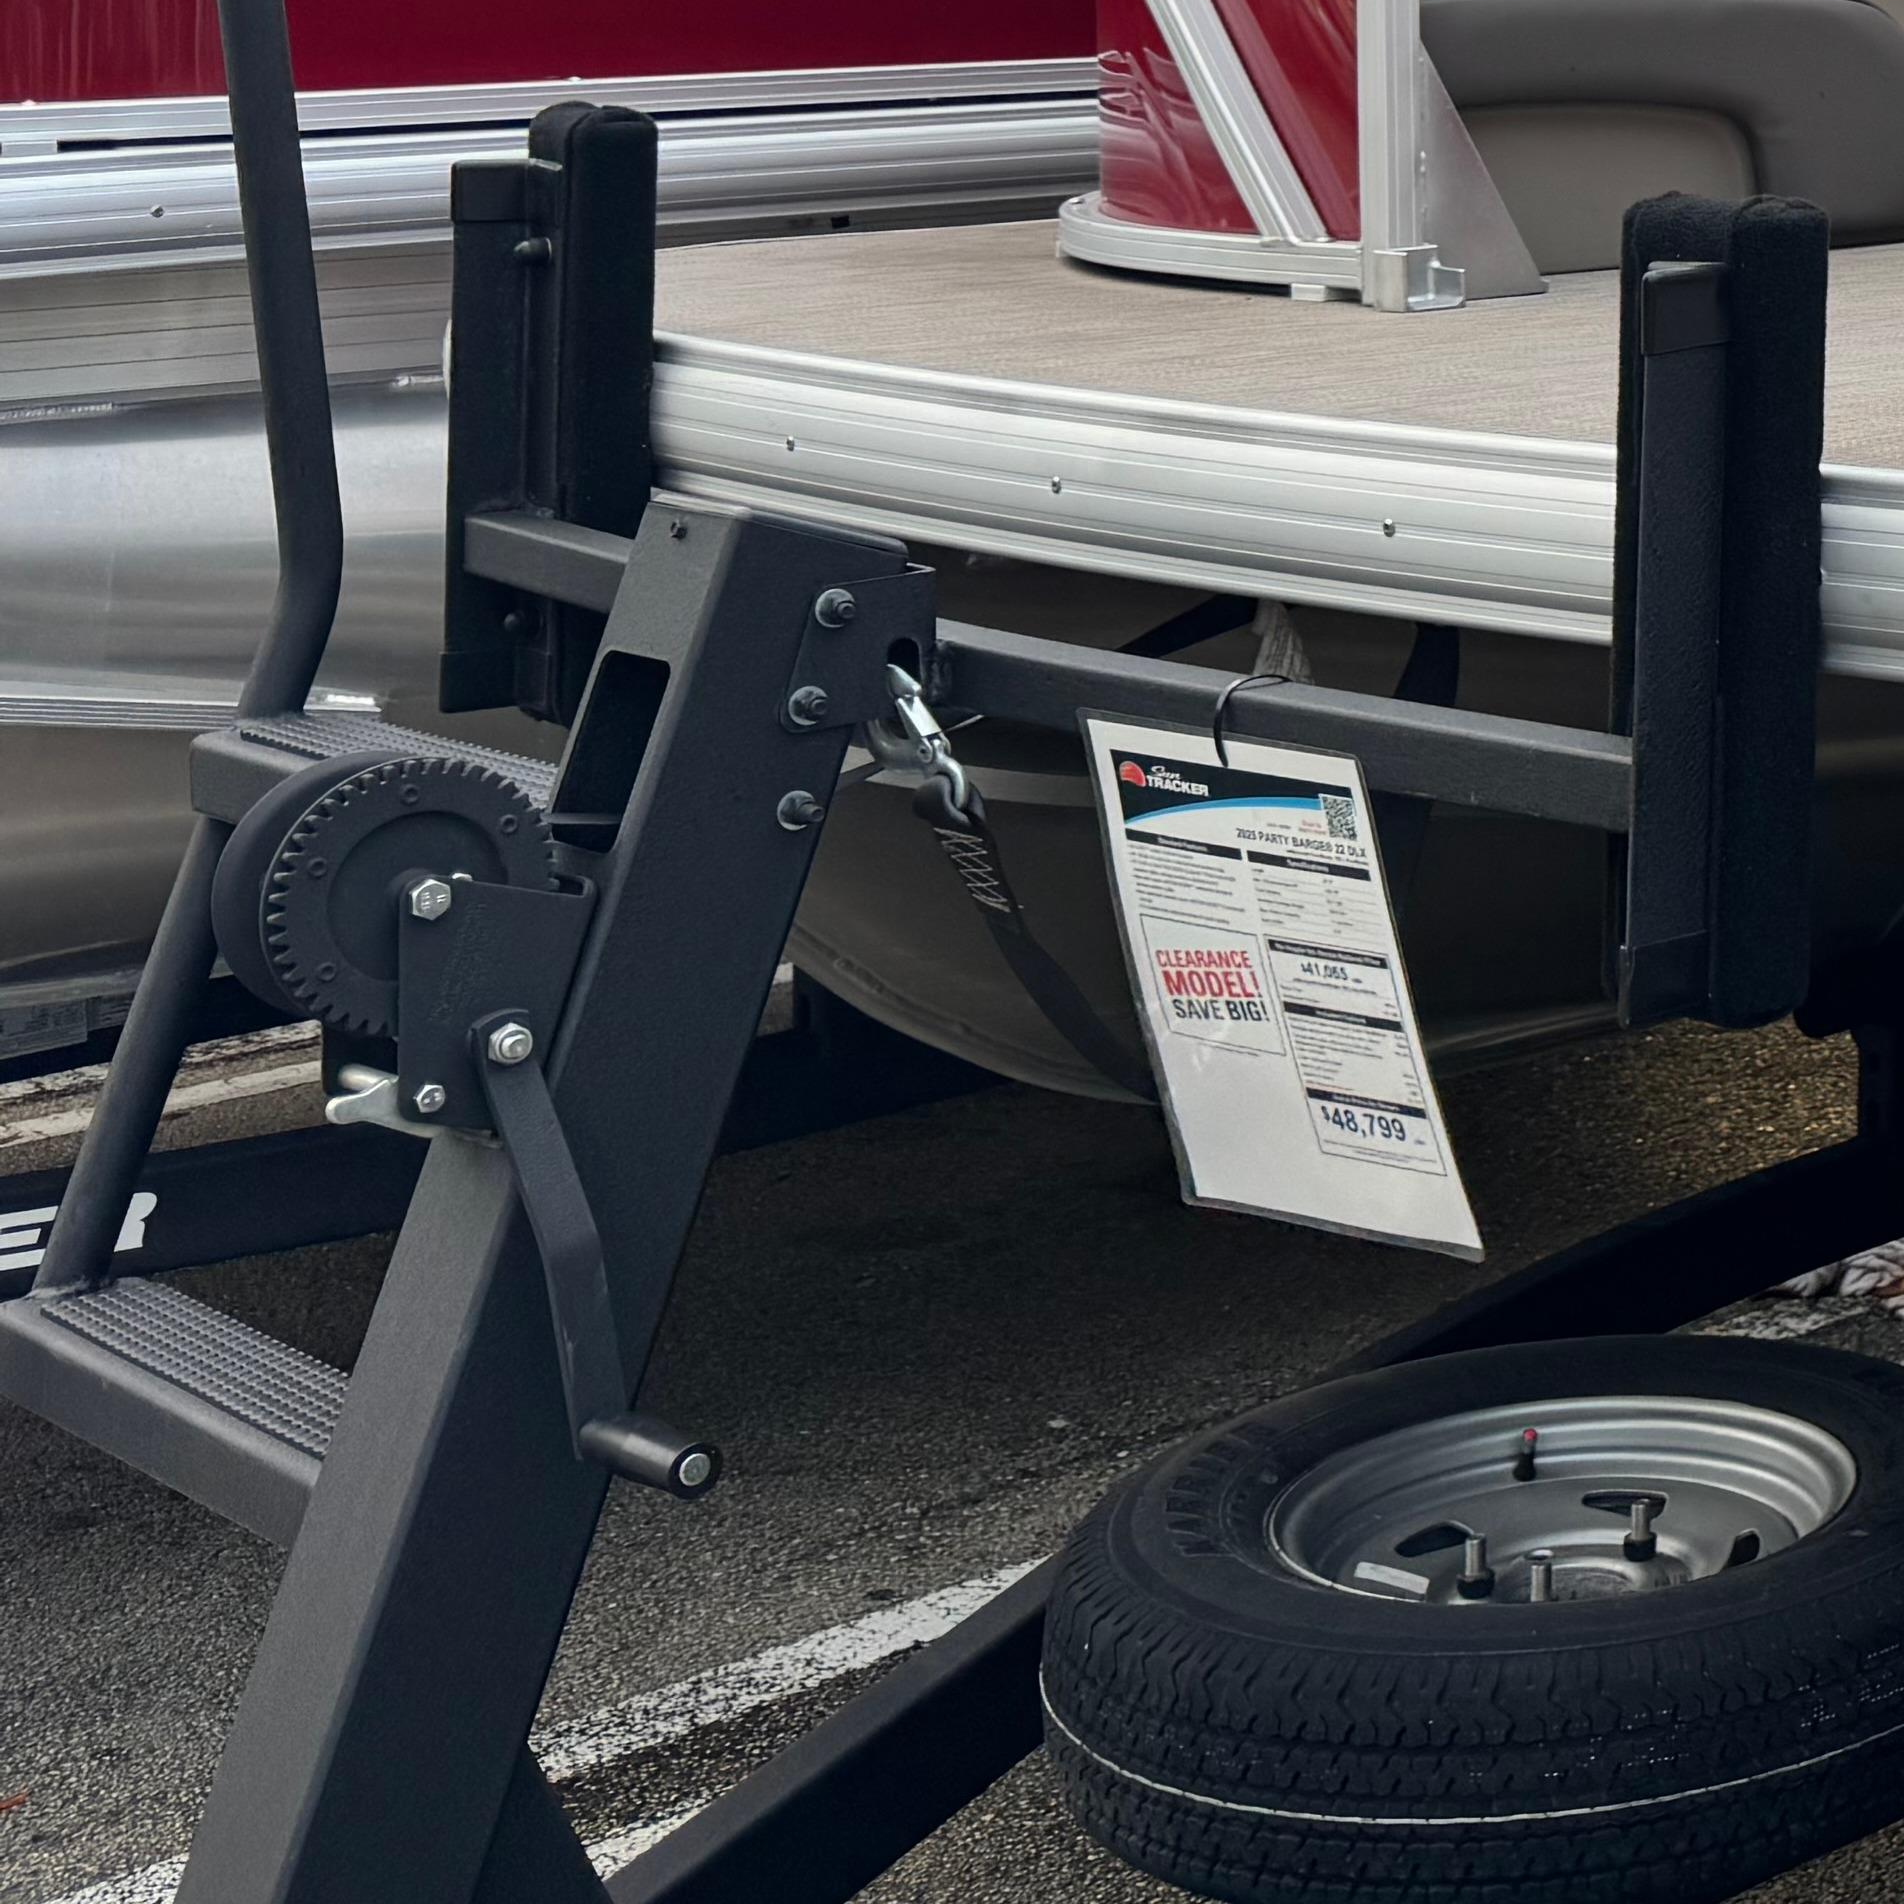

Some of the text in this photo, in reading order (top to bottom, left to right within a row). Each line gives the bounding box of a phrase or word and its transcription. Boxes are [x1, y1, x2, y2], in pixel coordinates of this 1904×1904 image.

[1151, 765, 1181, 780] Sun
[1146, 775, 1210, 797] TRACKER
[1258, 831, 1289, 846] PARTY
[1155, 949, 1253, 969] CLEARANCE
[1162, 970, 1263, 998] MODEL!
[1172, 999, 1270, 1023] SAVE BIG!
[1321, 1105, 1407, 1142] $48,799
